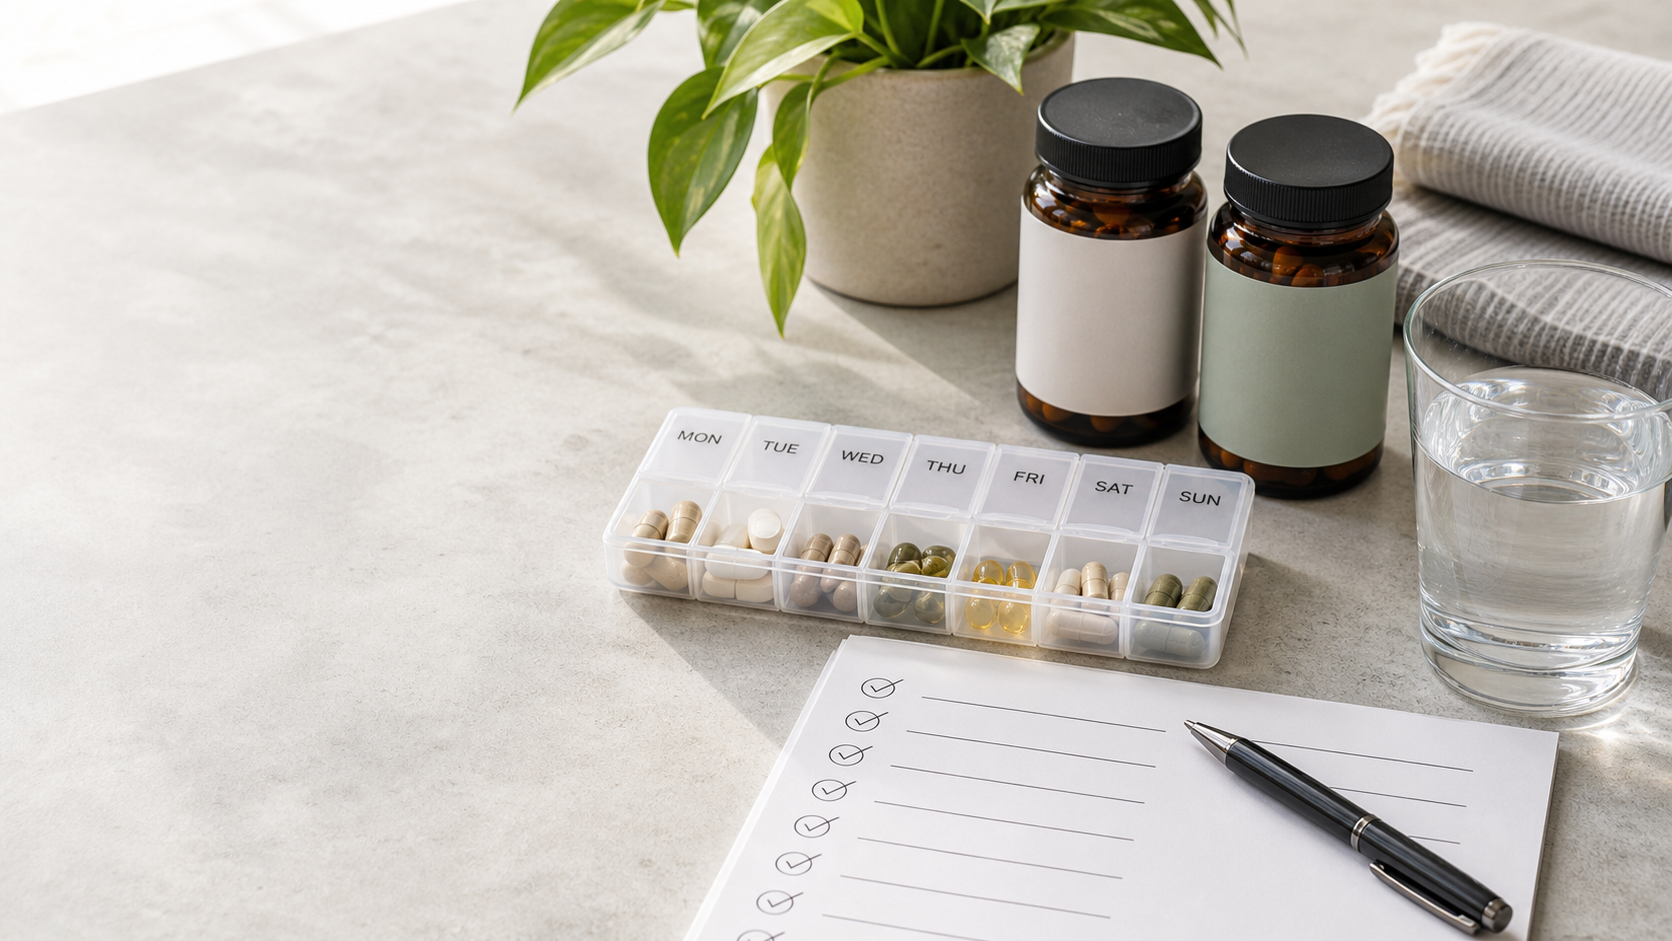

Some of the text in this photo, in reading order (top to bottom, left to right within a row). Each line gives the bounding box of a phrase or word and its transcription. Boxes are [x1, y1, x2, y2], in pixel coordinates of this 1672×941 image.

[677, 430, 722, 445] MON
[763, 440, 800, 455] TUE
[841, 449, 884, 465] WED
[926, 459, 967, 475] THU
[1013, 470, 1046, 485] FRI
[1094, 480, 1134, 495] SAT
[1178, 490, 1222, 507] SUN
